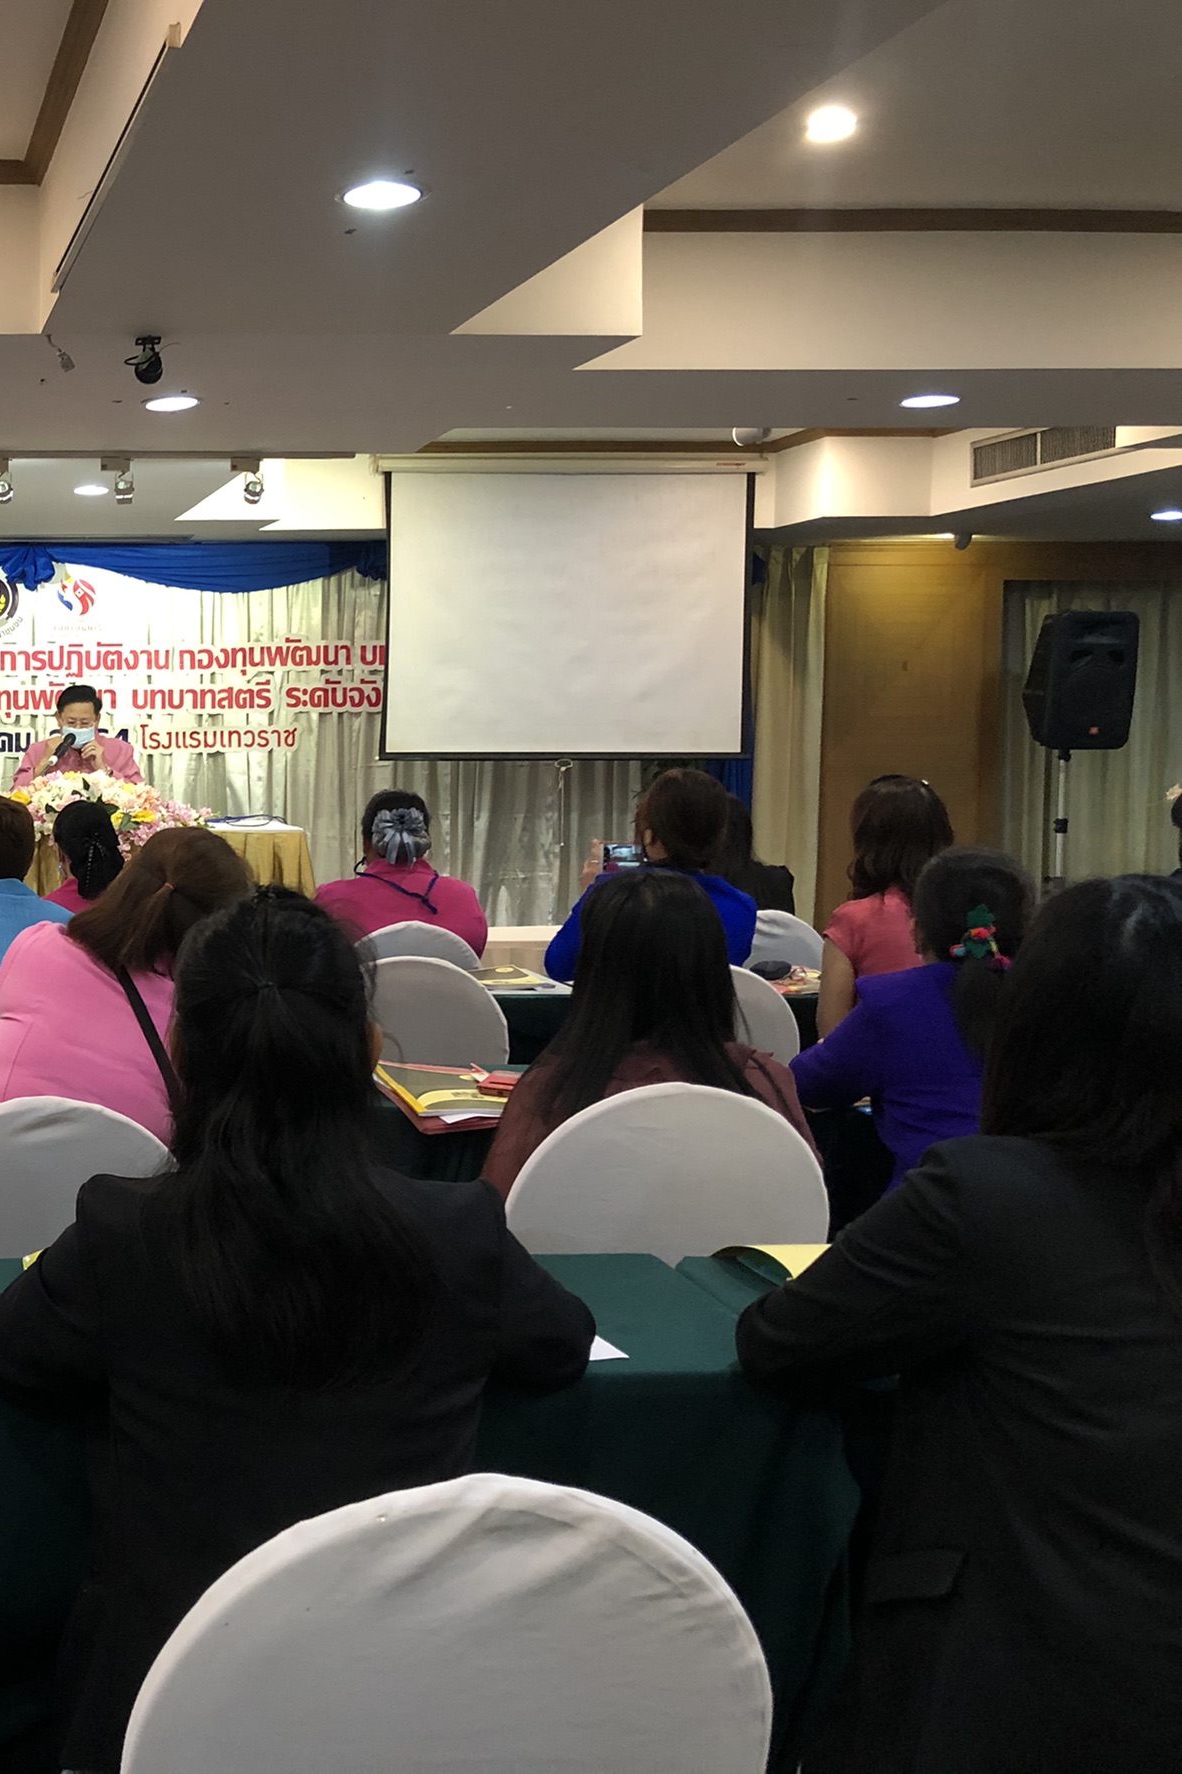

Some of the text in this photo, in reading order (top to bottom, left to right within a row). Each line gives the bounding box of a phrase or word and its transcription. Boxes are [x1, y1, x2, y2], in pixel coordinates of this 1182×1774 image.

[0, 641, 171, 678] การปฏิบัติงาน
[179, 637, 352, 677] กองทุนพัฒนา
[131, 679, 272, 710] บทบาทสตรี
[140, 723, 298, 751] โรงแรมเทวราช
